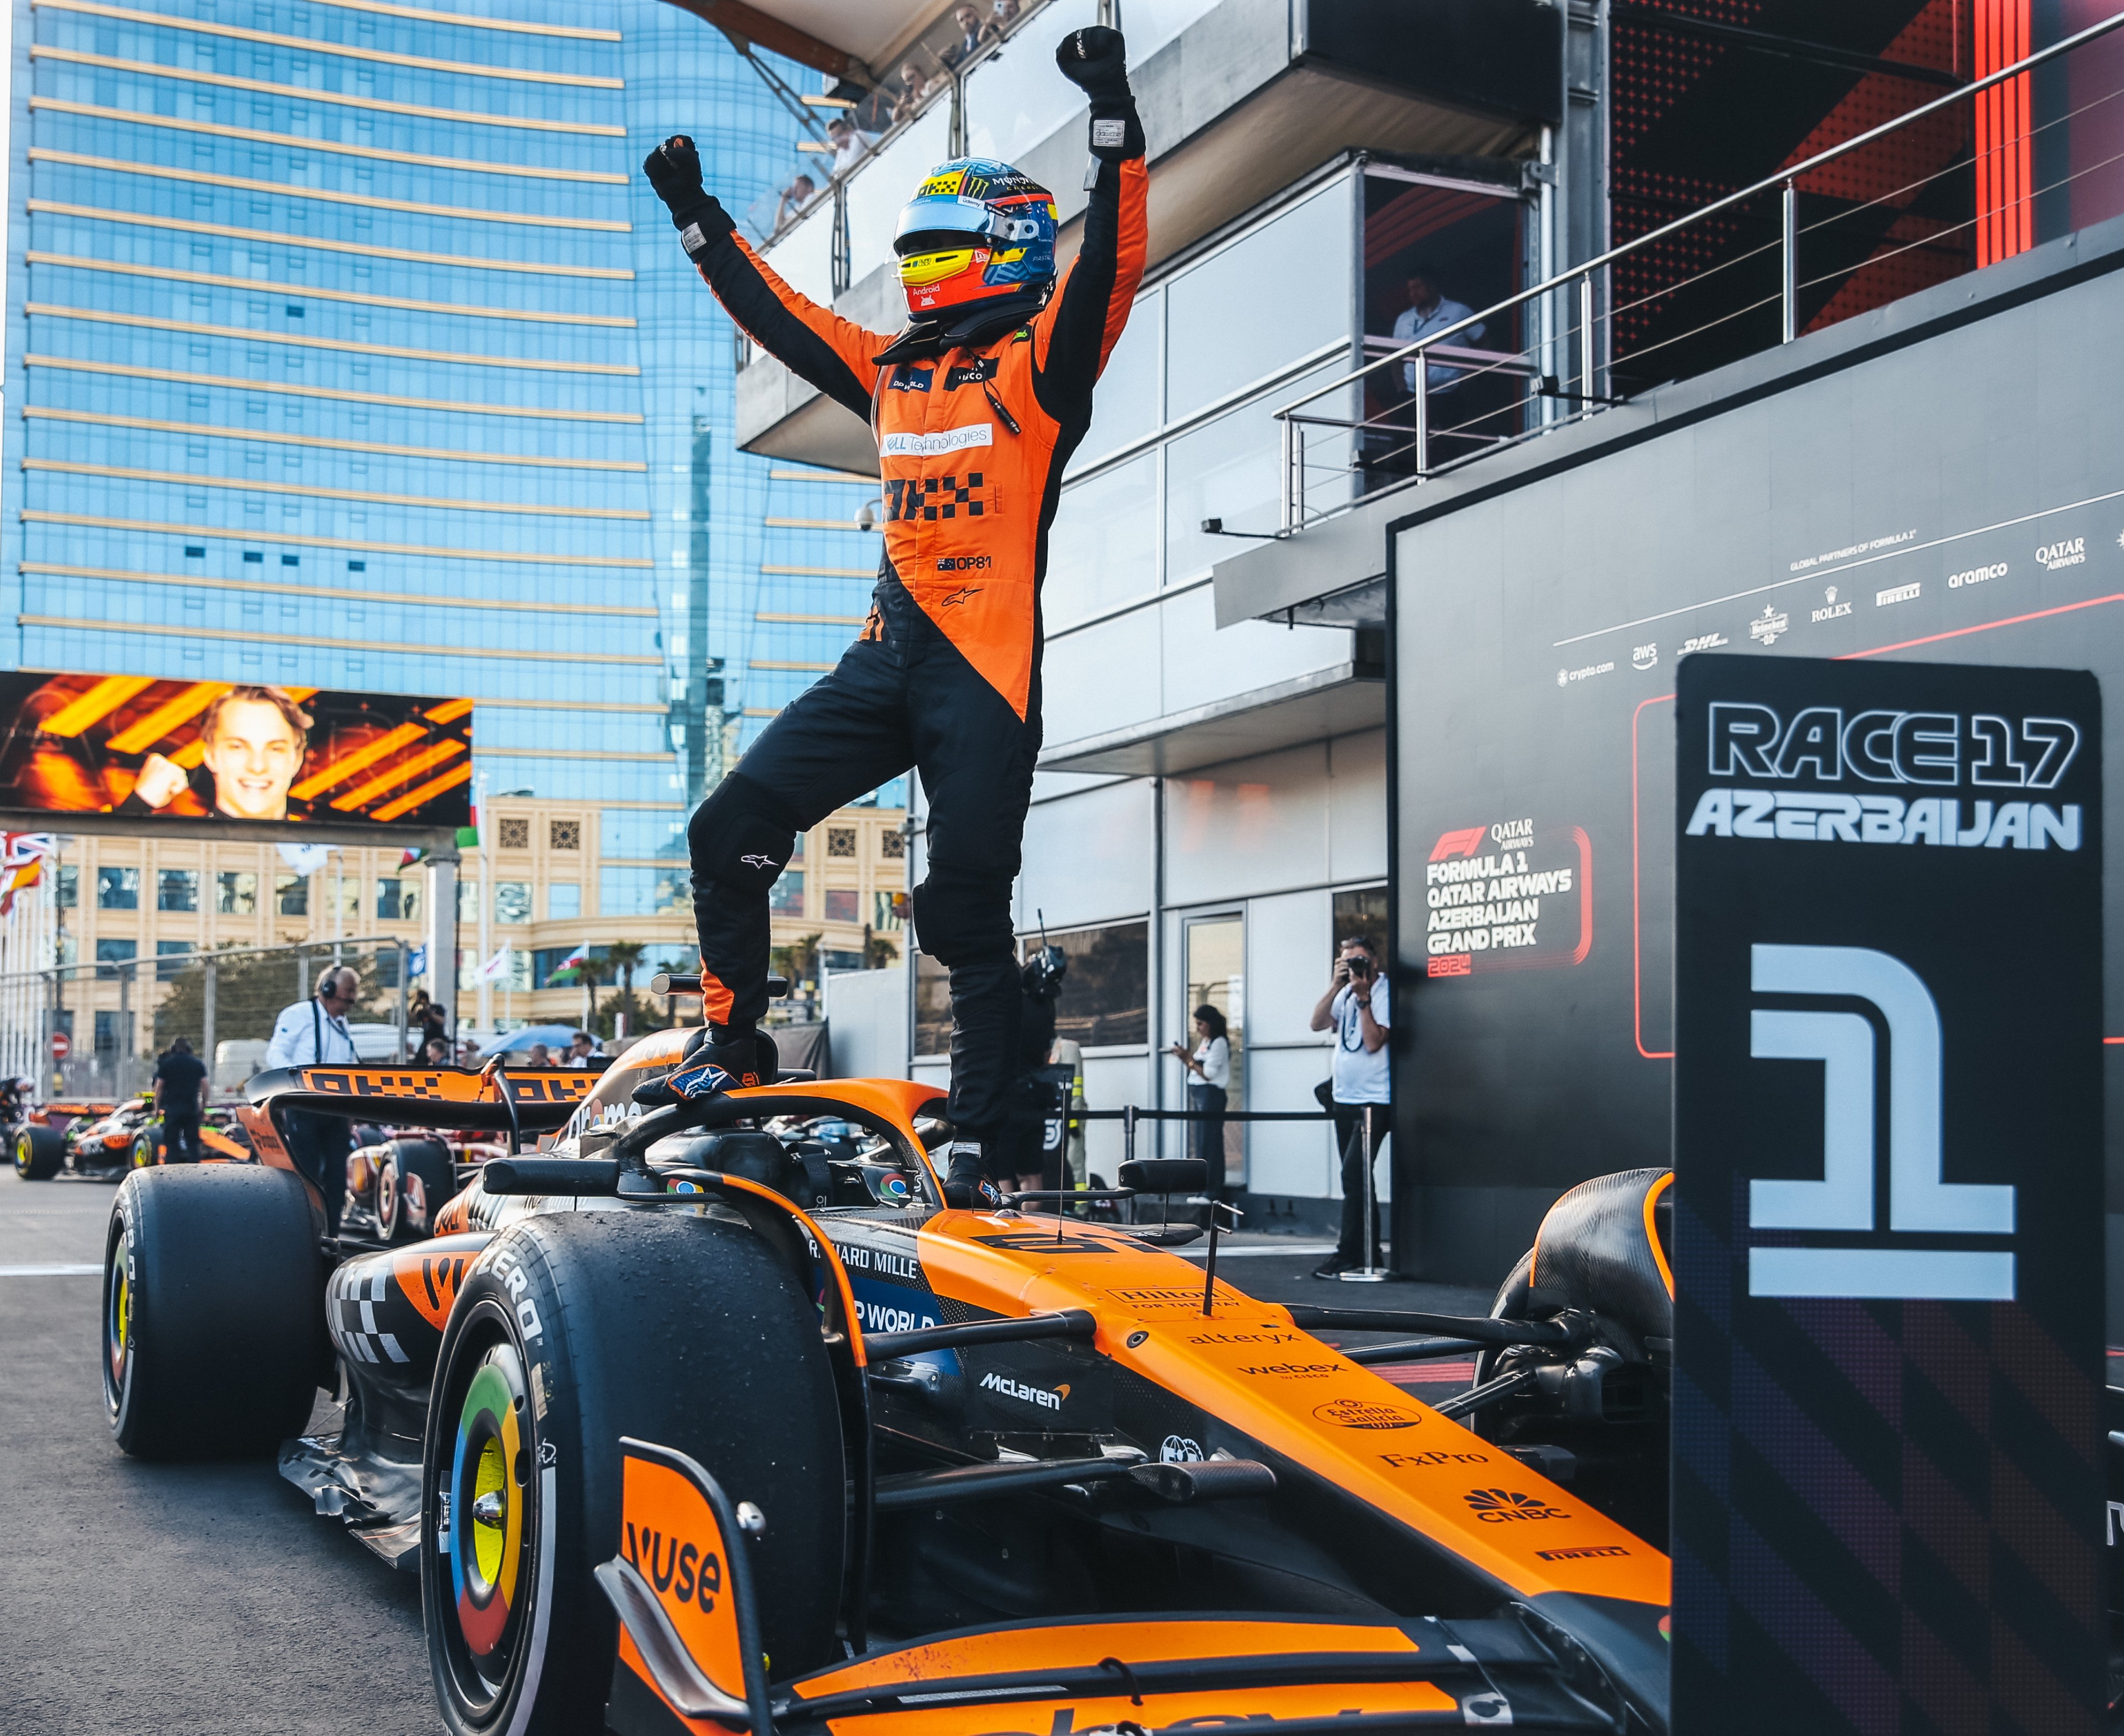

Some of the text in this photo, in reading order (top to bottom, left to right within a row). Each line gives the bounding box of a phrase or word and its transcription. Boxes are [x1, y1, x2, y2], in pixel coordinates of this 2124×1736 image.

[913, 284, 940, 296] Android
[904, 381, 924, 390] WRLD
[1790, 558, 1819, 571] GLOBAL
[1819, 545, 1857, 564] PARTNERS
[1857, 543, 1868, 553] OF
[1869, 531, 1908, 550] FORMULA
[2035, 537, 2085, 564] QATAR
[956, 556, 991, 570] OP81
[2046, 553, 2086, 571] AIRWAYS
[1948, 562, 2008, 590] aramco
[1876, 582, 1921, 607] PIRELLI
[1811, 601, 1852, 623] ROLEX
[1632, 642, 1657, 660] aws
[1682, 633, 1722, 654] DHL
[1569, 660, 1615, 682] crypto.com
[1709, 702, 2081, 789] RACE 17
[1490, 818, 1533, 842] QATAR
[1685, 788, 2082, 852] AZERBAIJAN
[1500, 836, 1534, 851] AIRWAYS
[1427, 851, 1529, 886] FORMULA 1
[1427, 868, 1572, 908] QATAR AIRWAYS
[1427, 899, 1539, 932] AZERBAIJAN
[1427, 922, 1537, 955] GRAND PRIX
[1428, 955, 1470, 976] 2024
[509, 1079, 597, 1101] OK
[1750, 945, 2016, 1300] 1
[875, 1252, 917, 1279] MILLE
[477, 1244, 543, 1341] ZERO
[1187, 1333, 1301, 1345] alteryx
[1237, 1363, 1348, 1375] webex
[980, 1373, 1060, 1410] McLaren
[1327, 1407, 1396, 1417] Estrella
[1339, 1413, 1405, 1423] Galicia
[1377, 1451, 1489, 1468] FxPro
[1477, 1507, 1572, 1523] CNBC
[1535, 1546, 1630, 1561] PIRELLI
